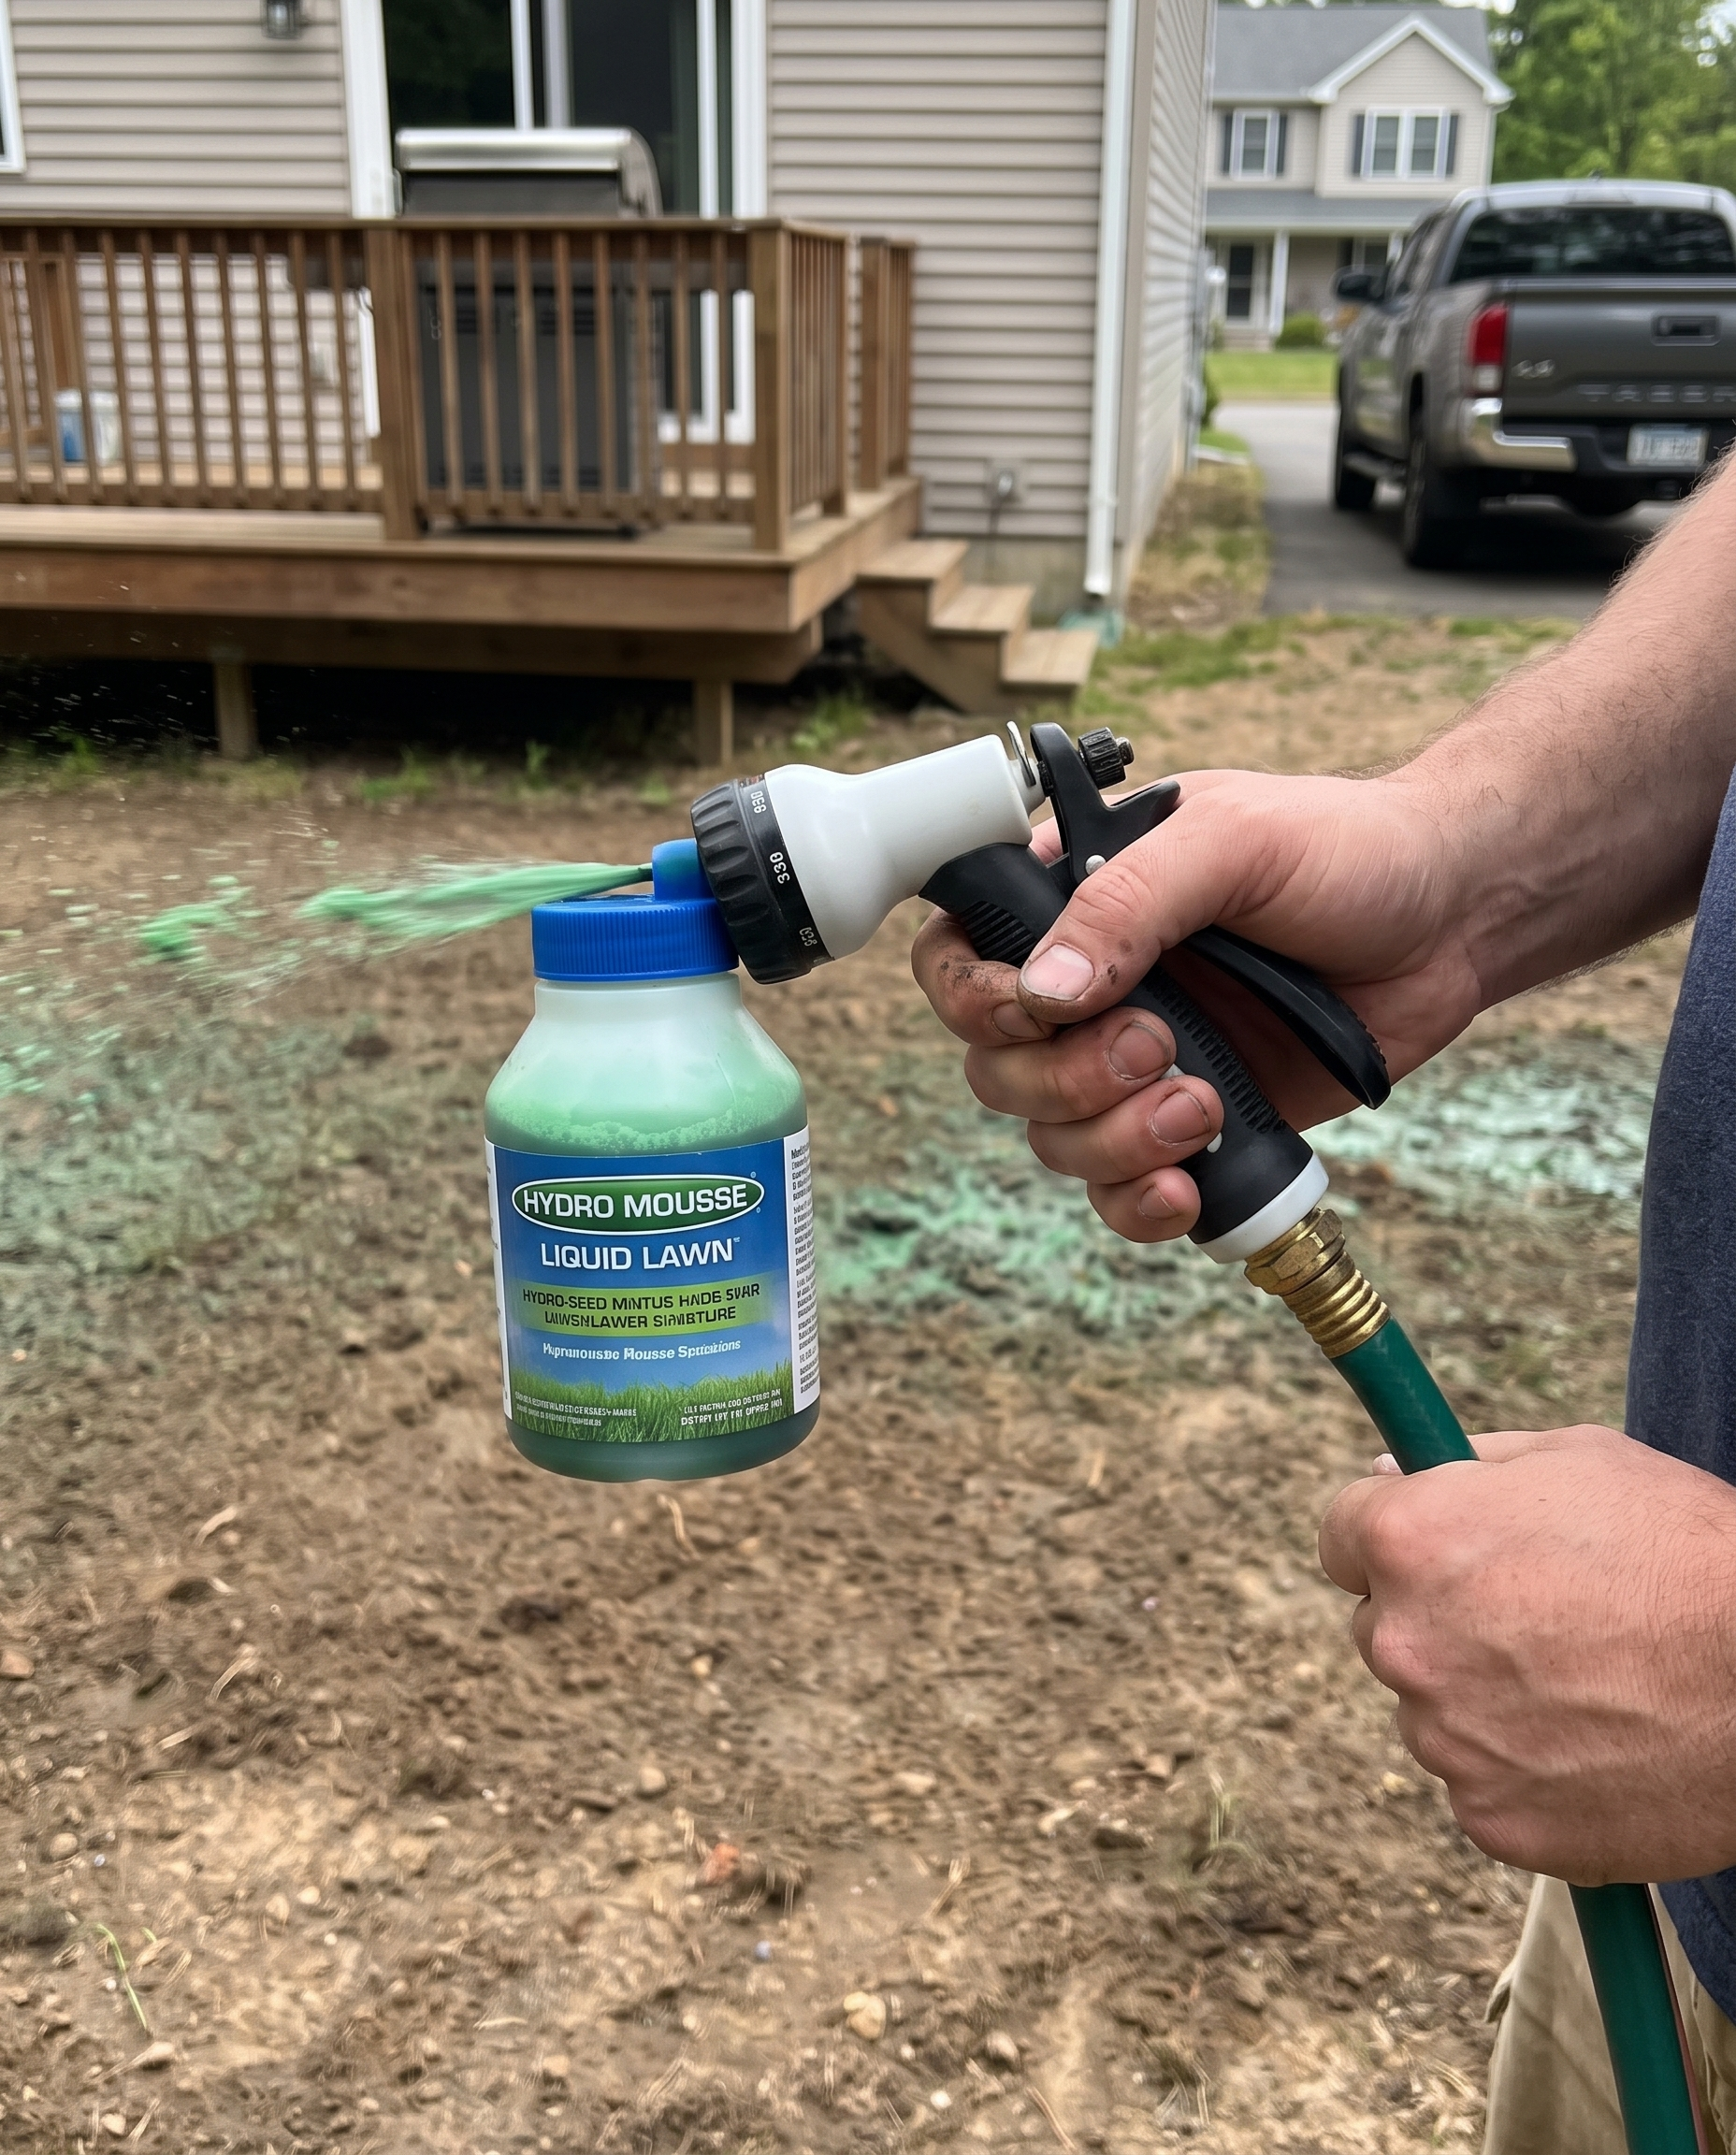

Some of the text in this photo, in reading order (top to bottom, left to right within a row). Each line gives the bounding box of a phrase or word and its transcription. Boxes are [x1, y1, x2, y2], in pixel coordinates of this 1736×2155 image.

[523, 1183, 747, 1218] HYDRO MOUSSE
[541, 1242, 631, 1270] LIQUID
[523, 1289, 607, 1310] HYDRO-SEED
